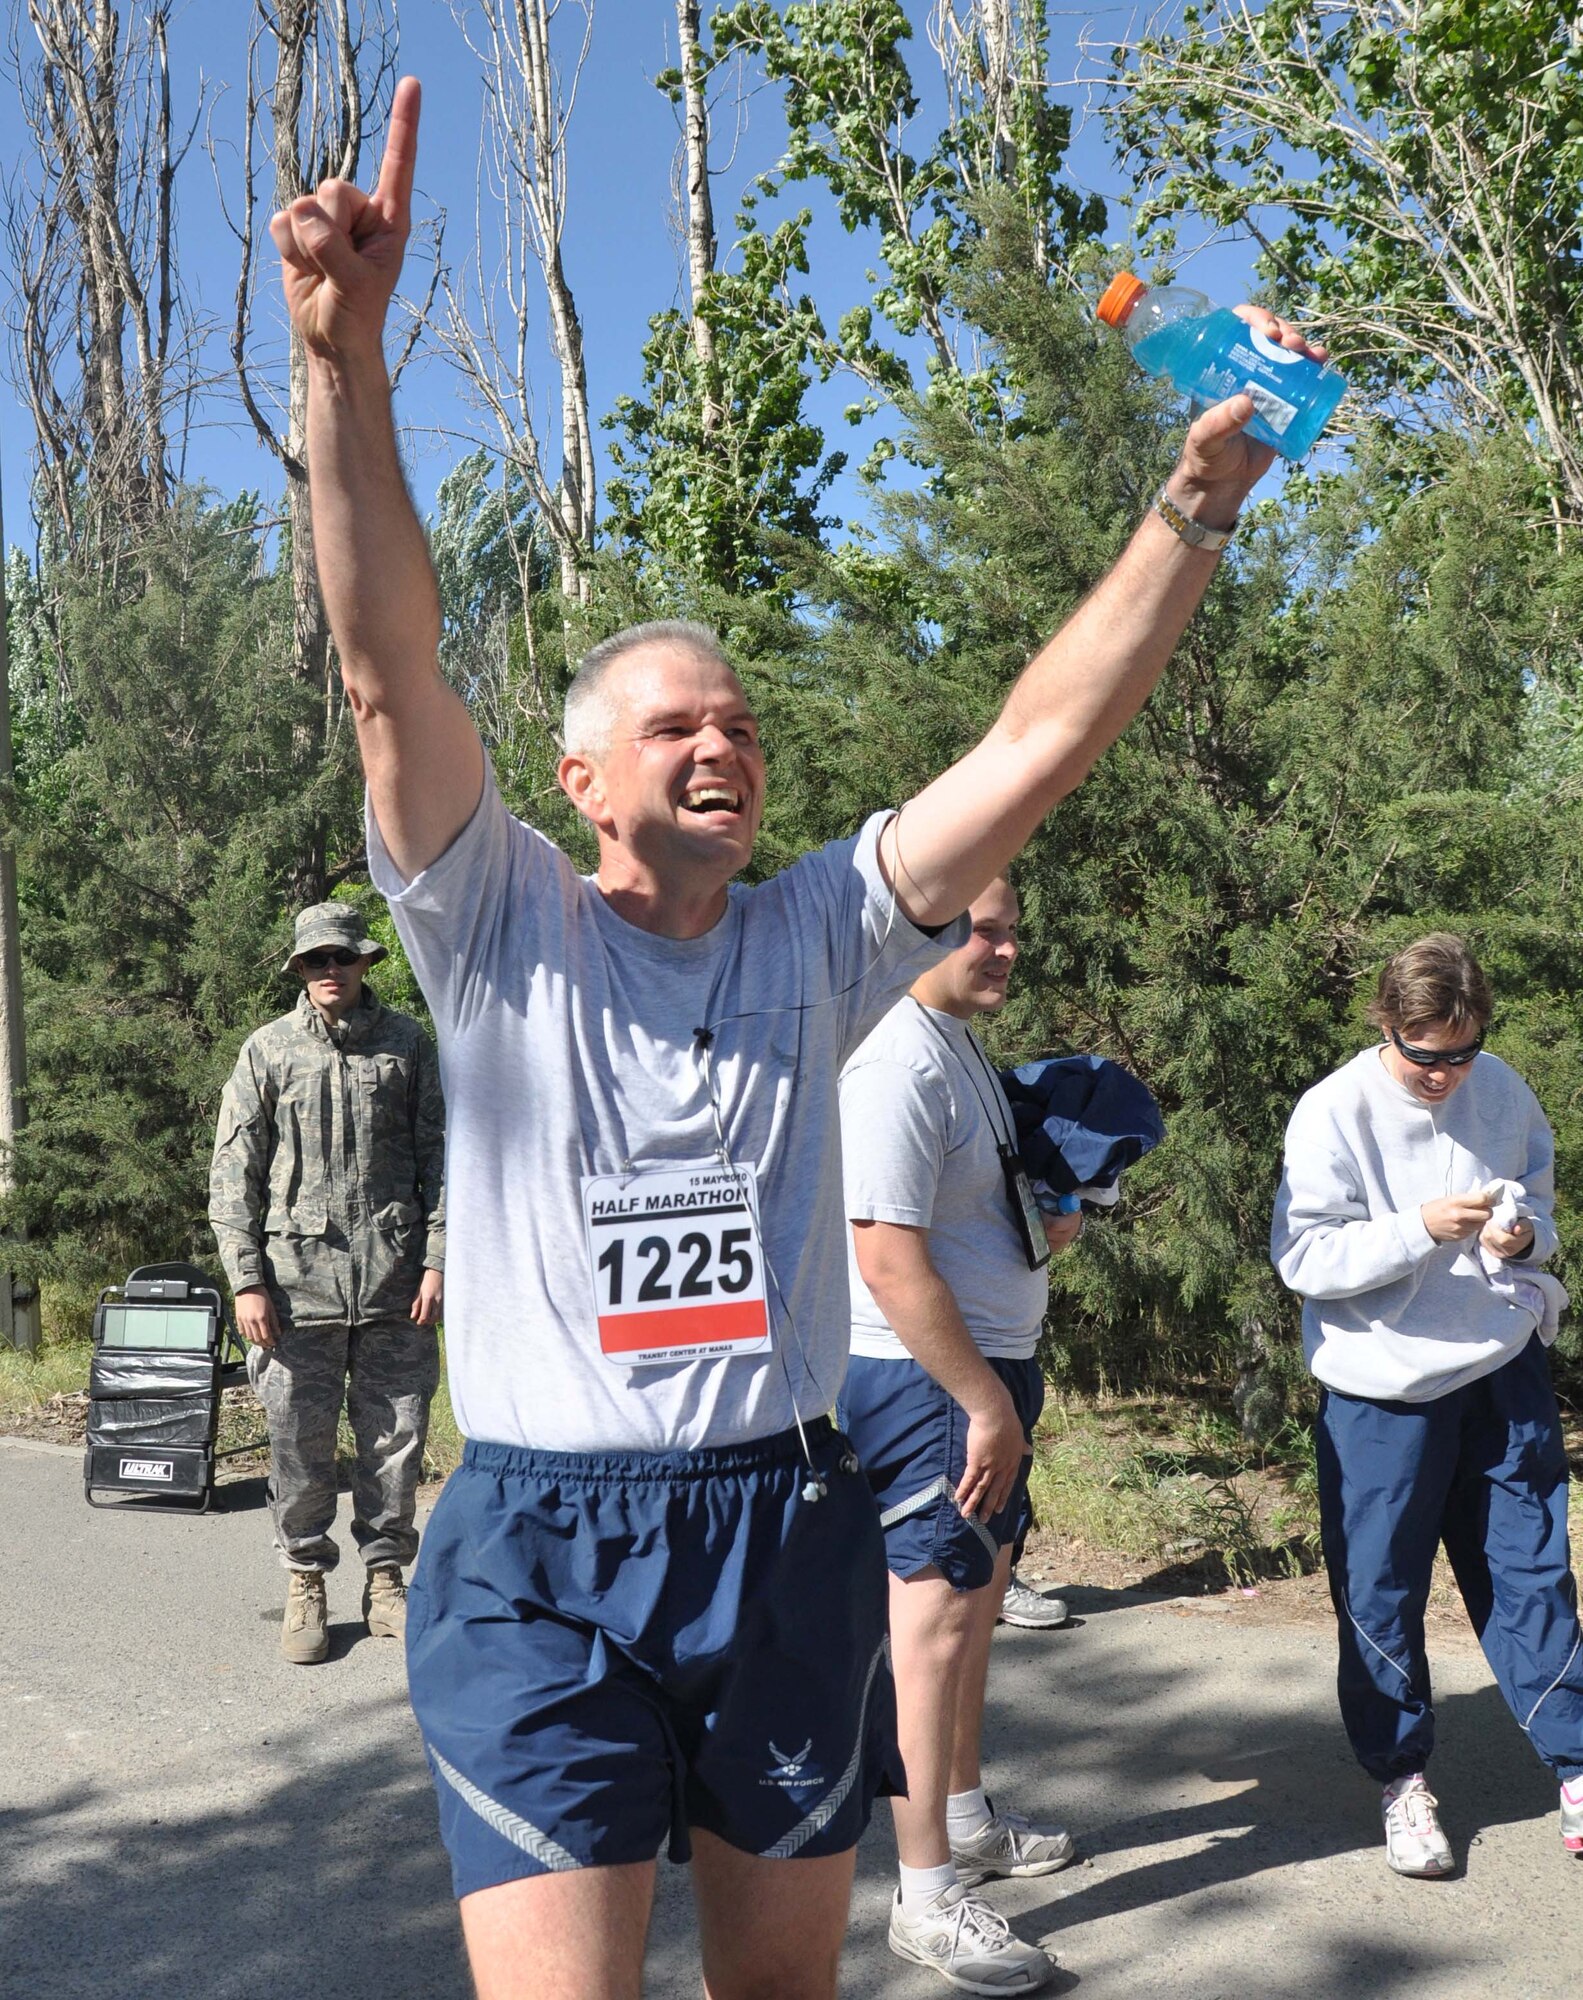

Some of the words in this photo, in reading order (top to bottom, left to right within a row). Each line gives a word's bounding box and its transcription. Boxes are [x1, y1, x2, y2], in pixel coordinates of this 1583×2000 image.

[689, 1177, 700, 1187] 15
[702, 1175, 723, 1185] MAY
[591, 1197, 640, 1216] HALF
[645, 1187, 749, 1211] MARATHON
[598, 1227, 754, 1306] 1225
[638, 1351, 668, 1361] TRANSIT
[669, 1347, 698, 1358] CENTER
[698, 1346, 708, 1355] AT
[708, 1344, 733, 1353] MANAS
[123, 1462, 167, 1477] ULTRAK
[777, 1779, 793, 1787] AIR
[793, 1776, 825, 1788] FORCE
